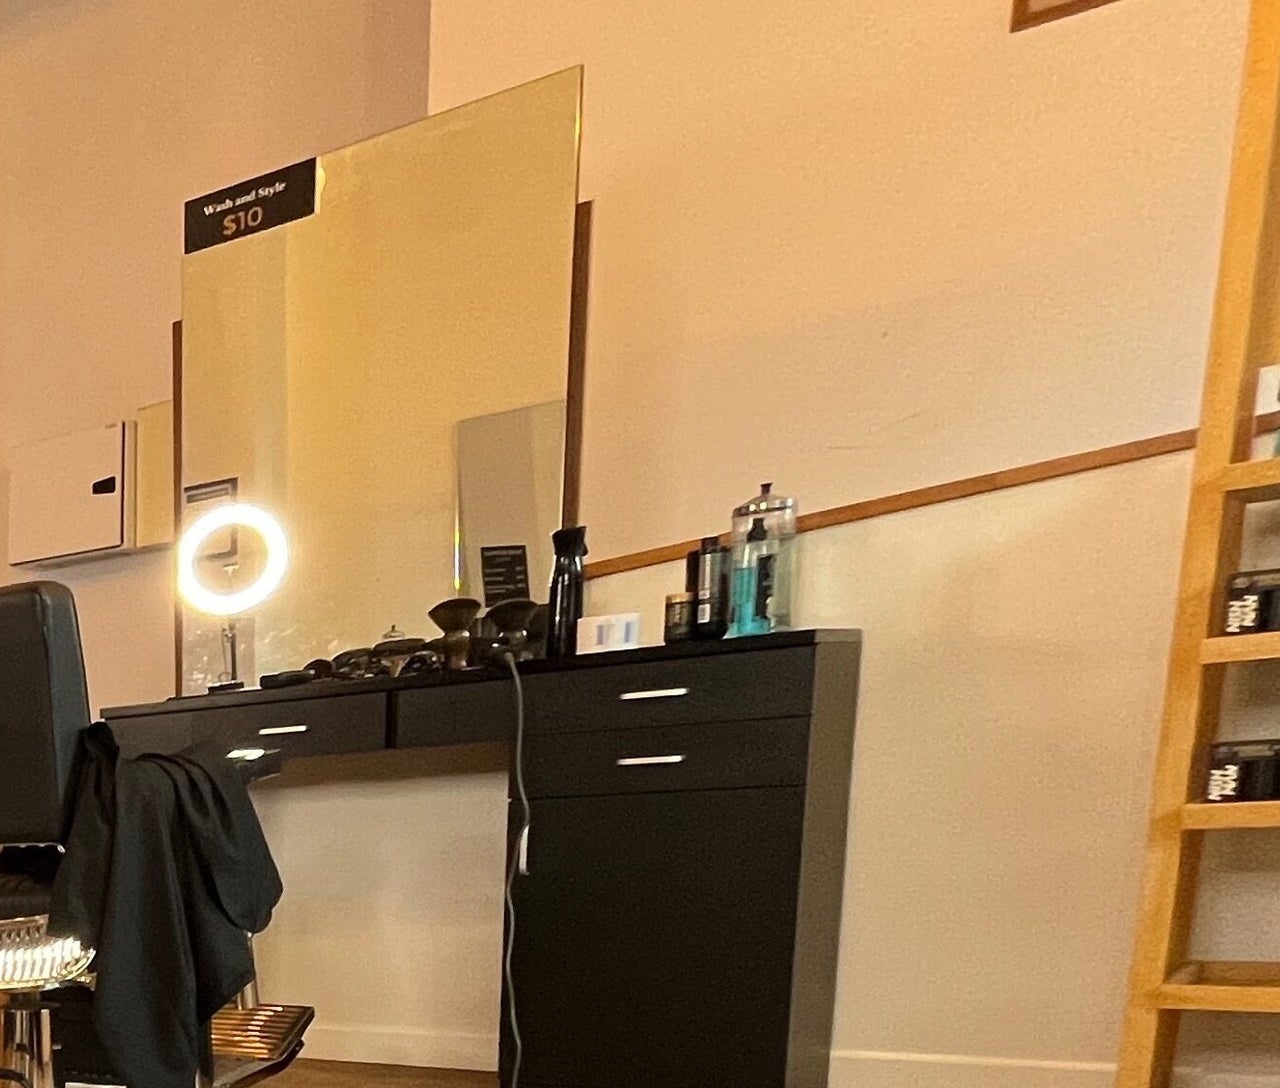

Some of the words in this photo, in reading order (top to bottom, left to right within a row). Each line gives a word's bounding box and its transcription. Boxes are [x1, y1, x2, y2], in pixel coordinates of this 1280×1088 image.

[203, 199, 233, 215] Wash
[235, 190, 256, 205] and
[257, 182, 287, 198] Style
[223, 206, 263, 235] $10
